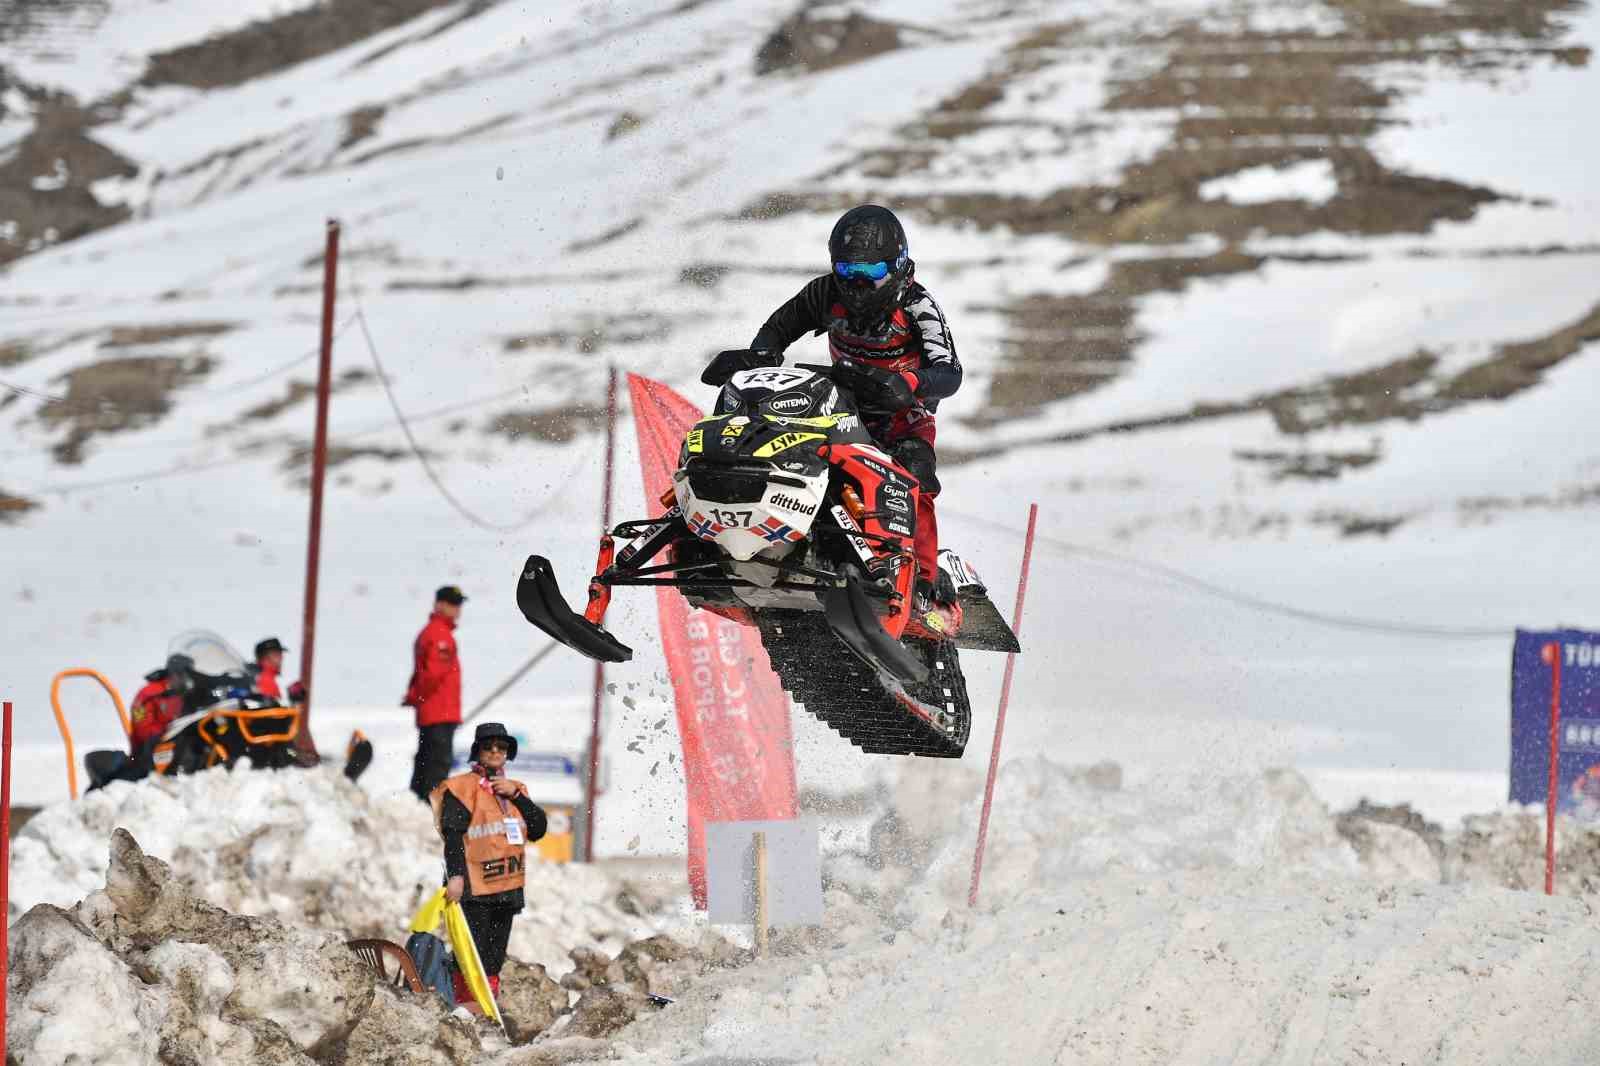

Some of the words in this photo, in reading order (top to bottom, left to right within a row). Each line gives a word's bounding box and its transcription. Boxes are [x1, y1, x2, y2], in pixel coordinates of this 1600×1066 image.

[743, 372, 802, 386] 137
[772, 397, 809, 410] ORTEMA
[769, 493, 817, 516] dittbud
[709, 508, 753, 528] 137
